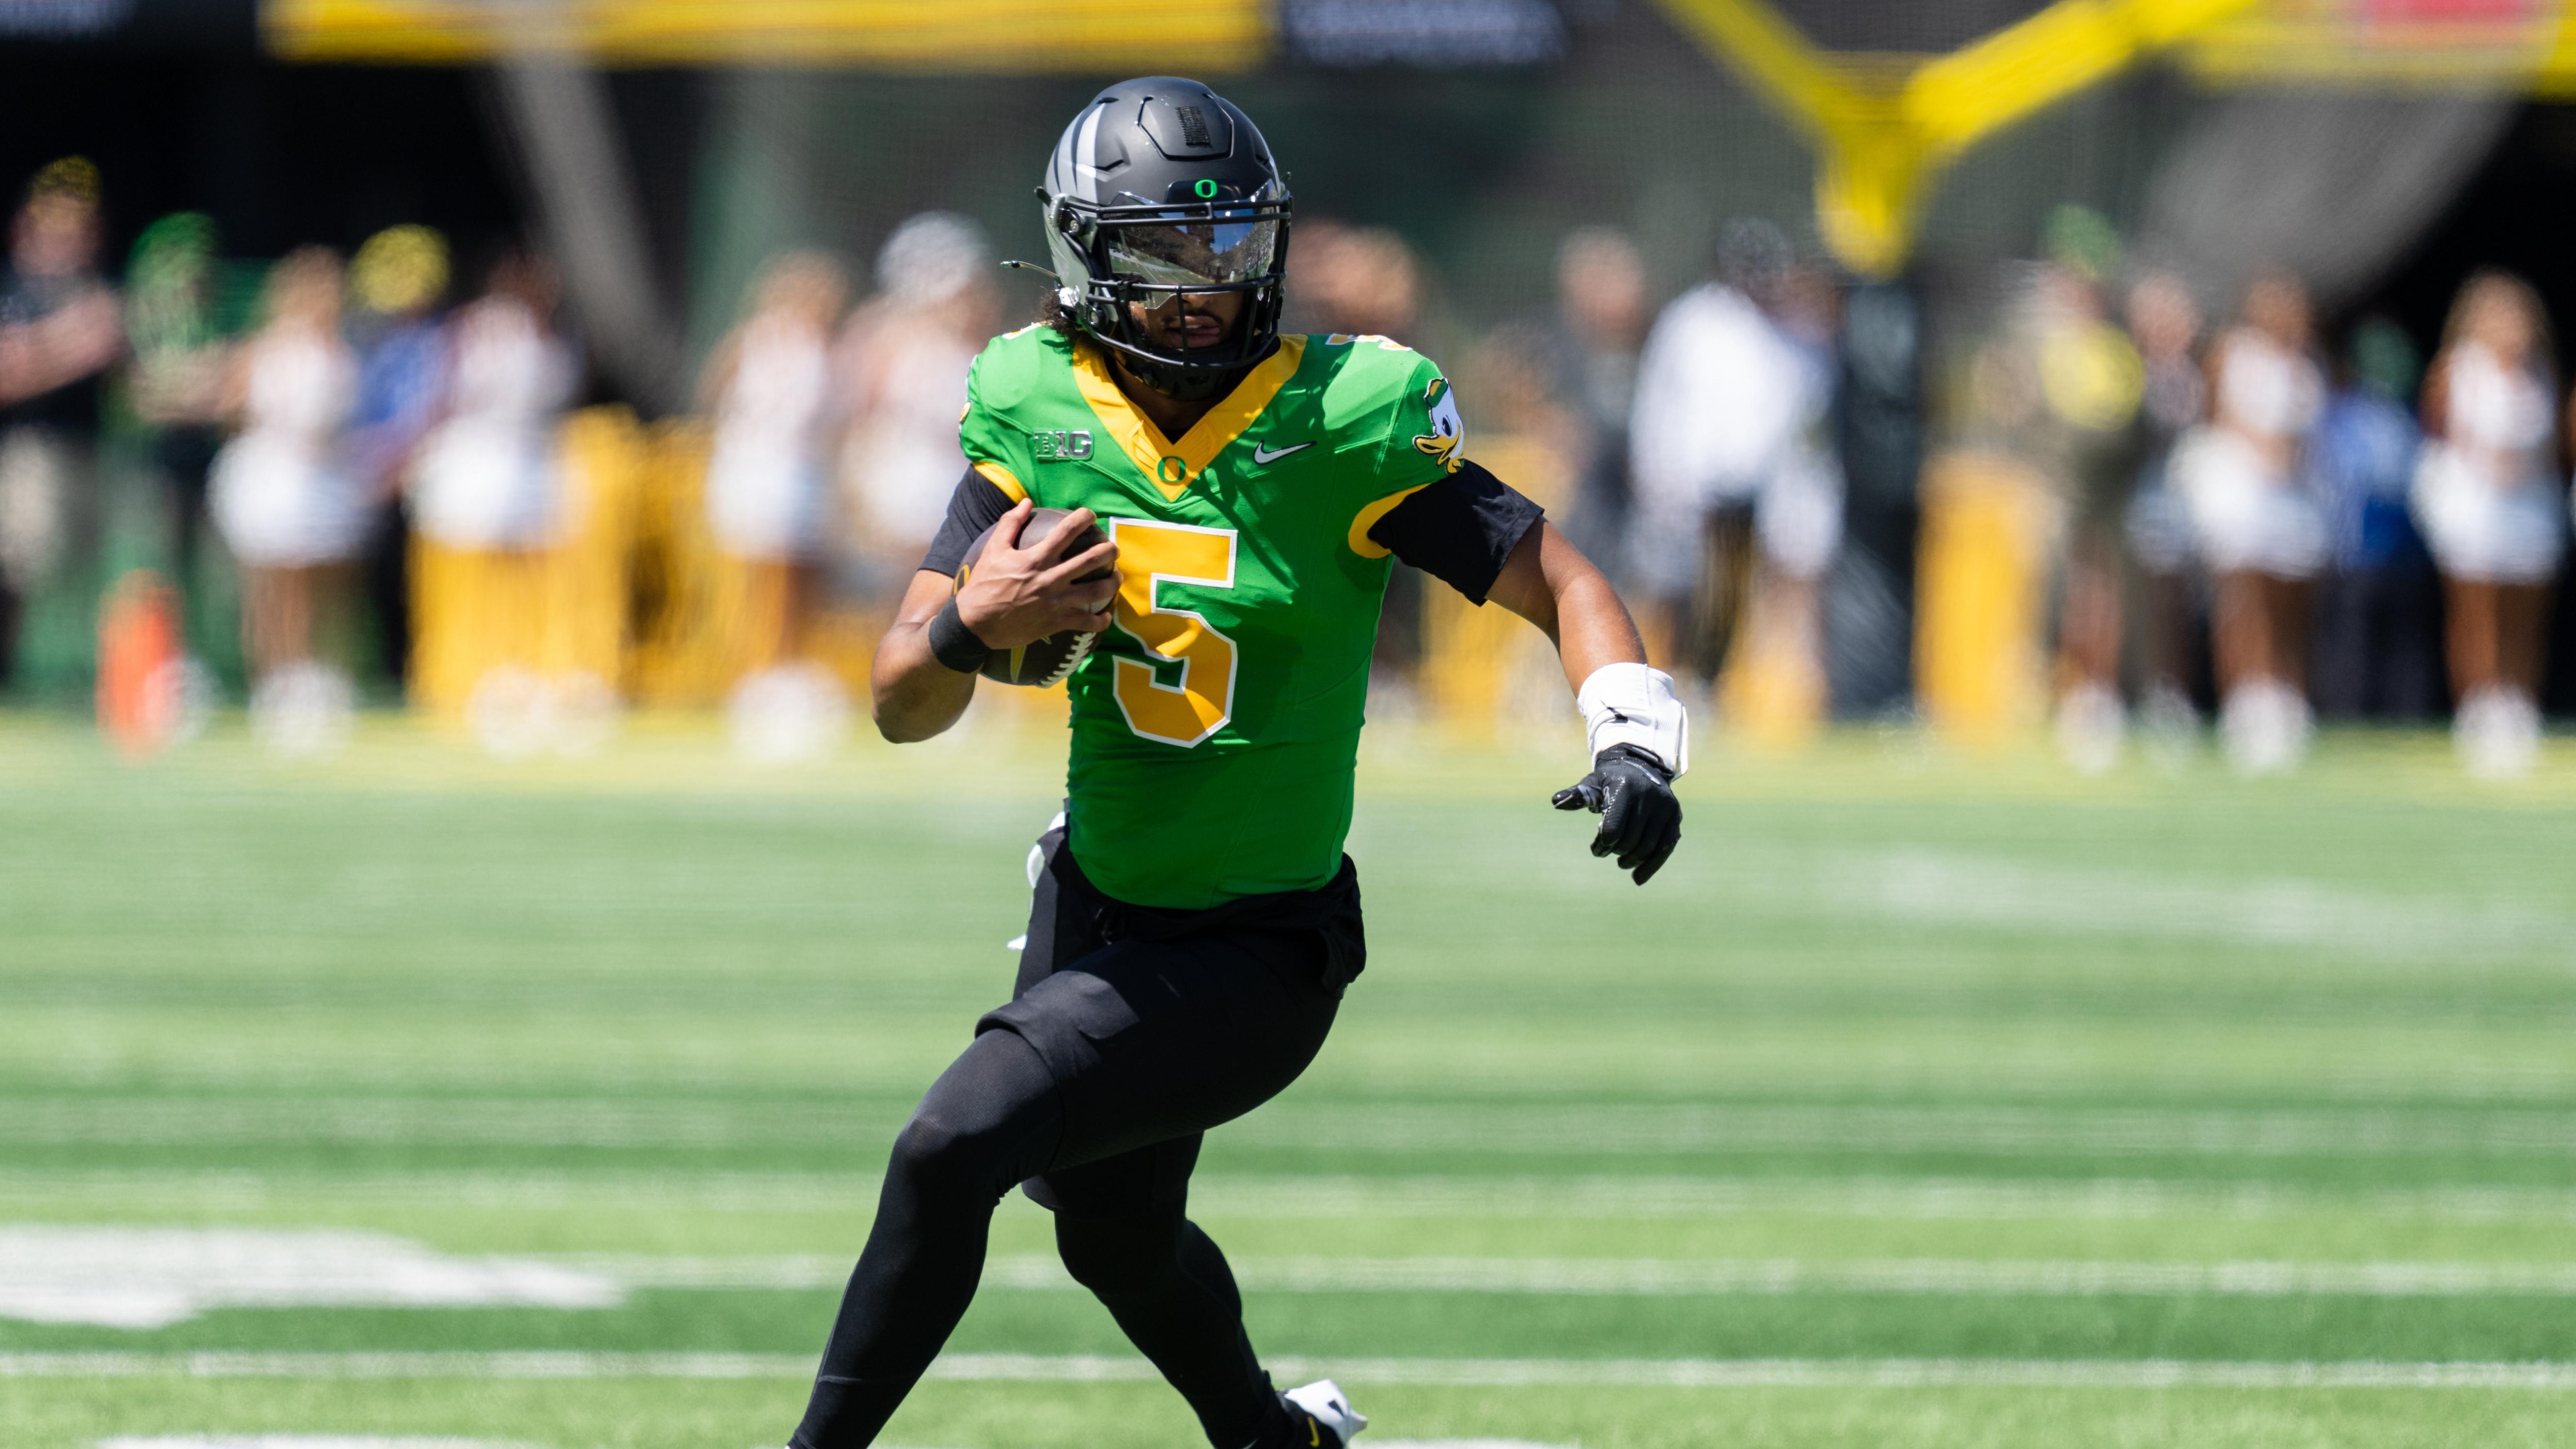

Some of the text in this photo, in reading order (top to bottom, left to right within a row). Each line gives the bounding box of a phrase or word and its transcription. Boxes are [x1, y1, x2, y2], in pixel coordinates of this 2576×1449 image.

[1195, 179, 1218, 198] O
[1157, 455, 1186, 483] O
[1109, 517, 1238, 748] 5
